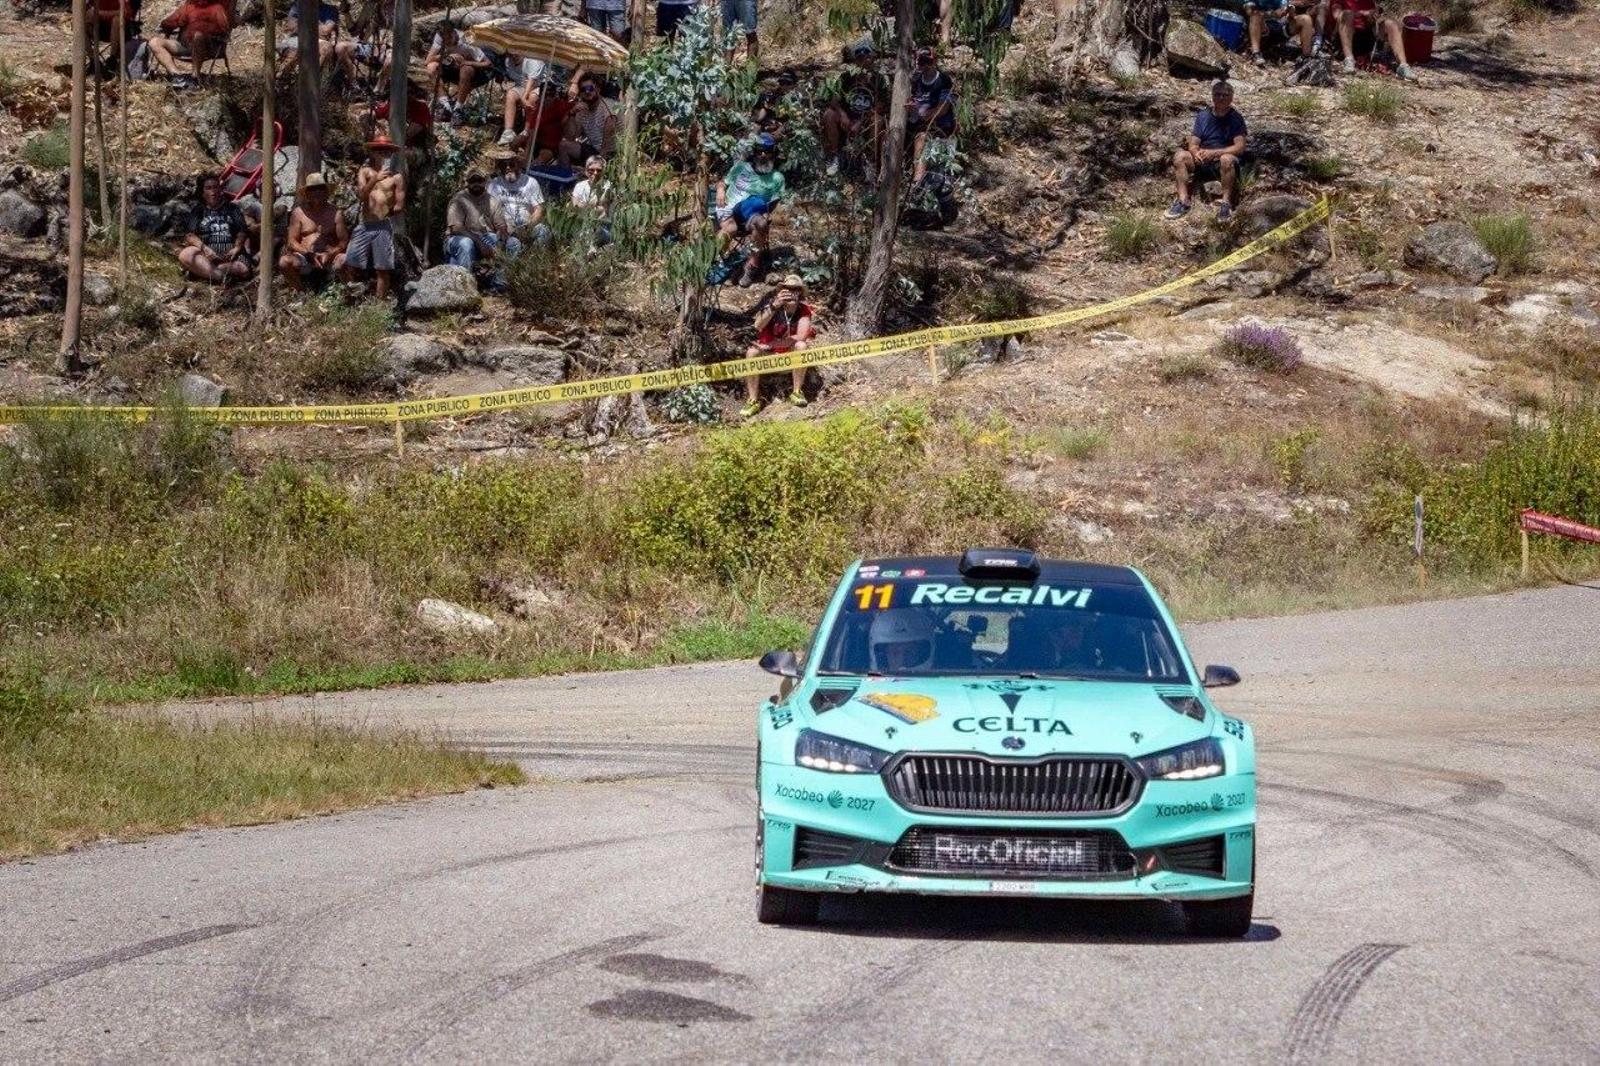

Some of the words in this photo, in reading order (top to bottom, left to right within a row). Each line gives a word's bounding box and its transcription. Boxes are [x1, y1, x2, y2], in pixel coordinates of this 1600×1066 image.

[230, 409, 257, 421] ZONA
[260, 410, 304, 421] PUBLICO
[314, 408, 341, 421] ZONA
[344, 407, 388, 419] PUBLICO
[398, 403, 425, 417] ZONA
[427, 399, 470, 413] PUBLICO
[479, 394, 507, 408] ZONA
[509, 389, 551, 404] PUBLICO
[561, 385, 587, 398] ZONA
[589, 379, 632, 393] PUBLICO
[641, 374, 668, 388] ZONA
[670, 368, 712, 384] PUBLICO
[722, 363, 748, 377] ZONA
[750, 357, 792, 371] PUBLICO
[801, 350, 827, 364] ZONA
[829, 344, 871, 359] PUBLICO
[880, 339, 905, 352] ZONA
[949, 327, 969, 338] ZONA
[854, 584, 895, 610] 11
[910, 583, 1093, 608] Recalvi
[952, 716, 1074, 736] CELTA
[775, 783, 824, 803] Xacobeo
[847, 796, 876, 812] 2027
[1155, 801, 1208, 818] Xacobeo
[1227, 793, 1246, 807] 2027
